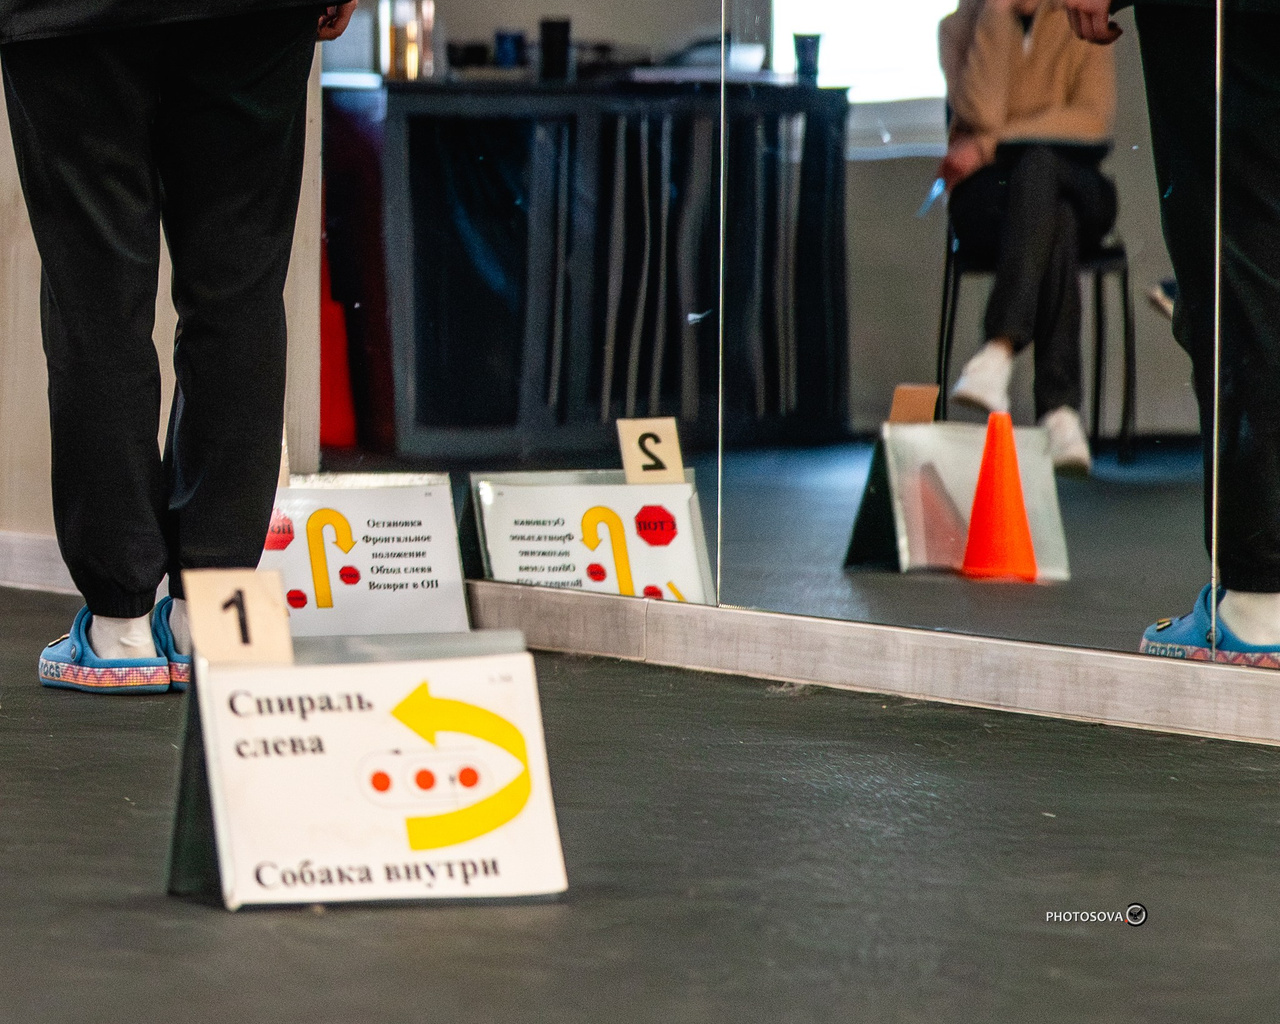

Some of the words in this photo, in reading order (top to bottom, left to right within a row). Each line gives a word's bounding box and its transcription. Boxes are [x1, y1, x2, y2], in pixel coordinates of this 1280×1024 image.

[271, 523, 291, 534] ОП
[366, 518, 423, 528] Остановка
[362, 534, 432, 545] Фронтальное
[372, 550, 427, 559] положение
[404, 565, 432, 574] слева
[368, 581, 409, 592] Возврат
[421, 579, 439, 589] ОП
[223, 588, 251, 645] 1
[228, 689, 374, 722] Спираль
[234, 734, 326, 759] слева
[253, 858, 373, 890] Собака
[383, 856, 501, 889] внутри
